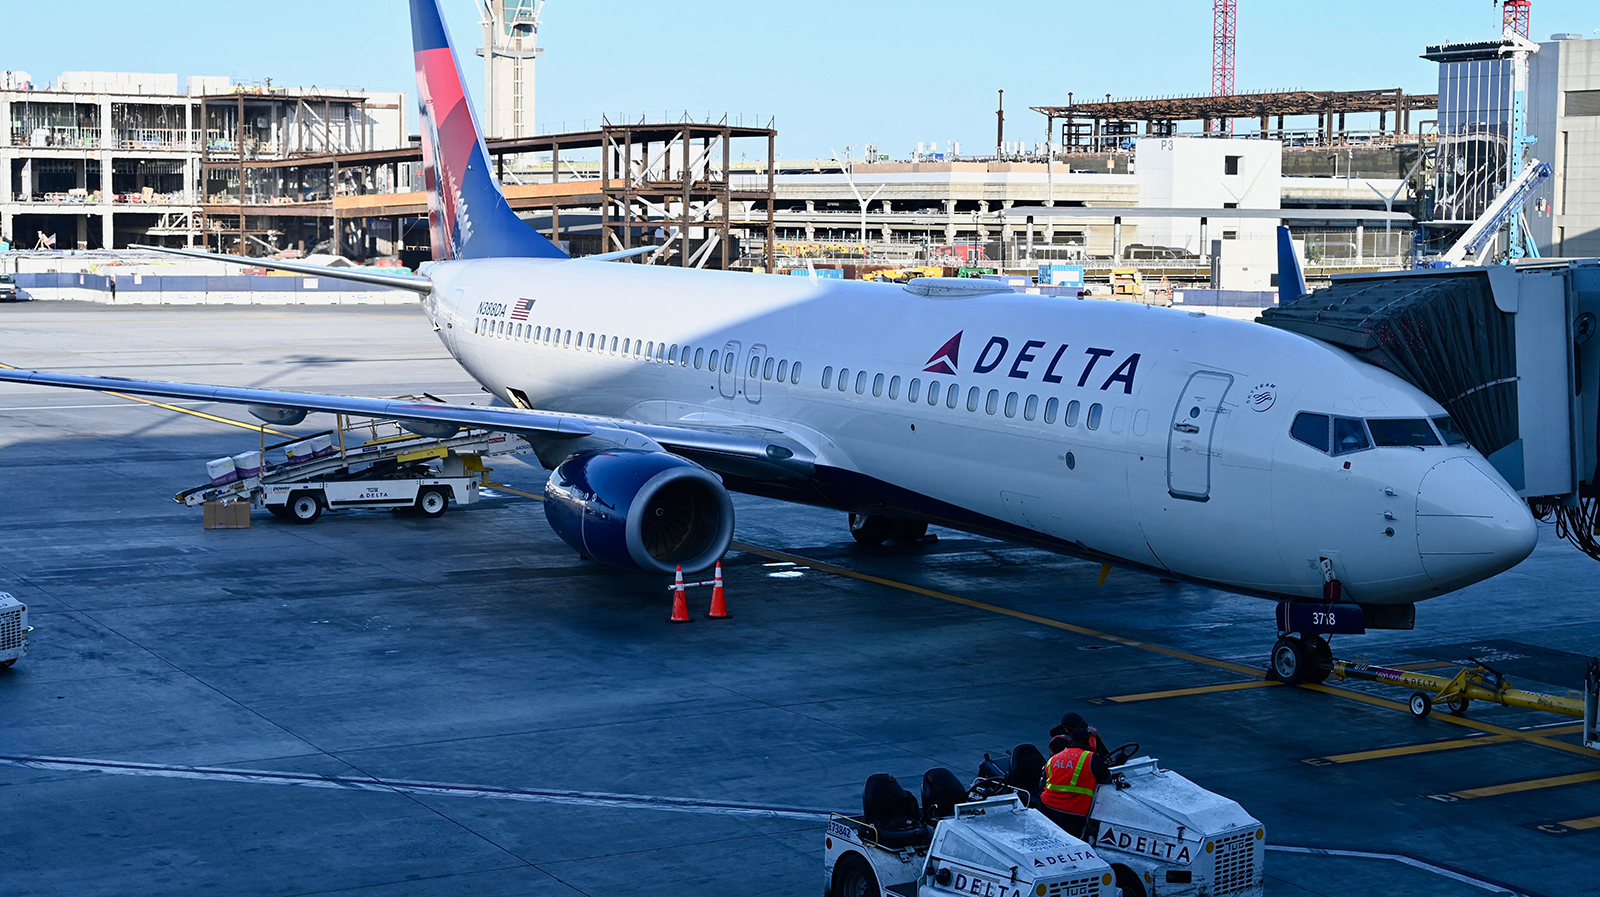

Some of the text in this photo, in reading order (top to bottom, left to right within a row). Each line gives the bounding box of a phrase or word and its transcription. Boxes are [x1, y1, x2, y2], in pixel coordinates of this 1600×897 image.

[1161, 140, 1173, 150] P3
[476, 301, 507, 317] N388DA
[972, 336, 1142, 395] DELTA
[1246, 383, 1276, 404] SKYTEAM
[1312, 612, 1336, 625] 3718
[1411, 678, 1437, 688] DELTA
[1053, 760, 1074, 769] ALA
[1118, 832, 1190, 862] DELTA
[1225, 839, 1245, 851] TUG
[1046, 851, 1095, 865] DELTA
[1062, 884, 1087, 897] TUG
